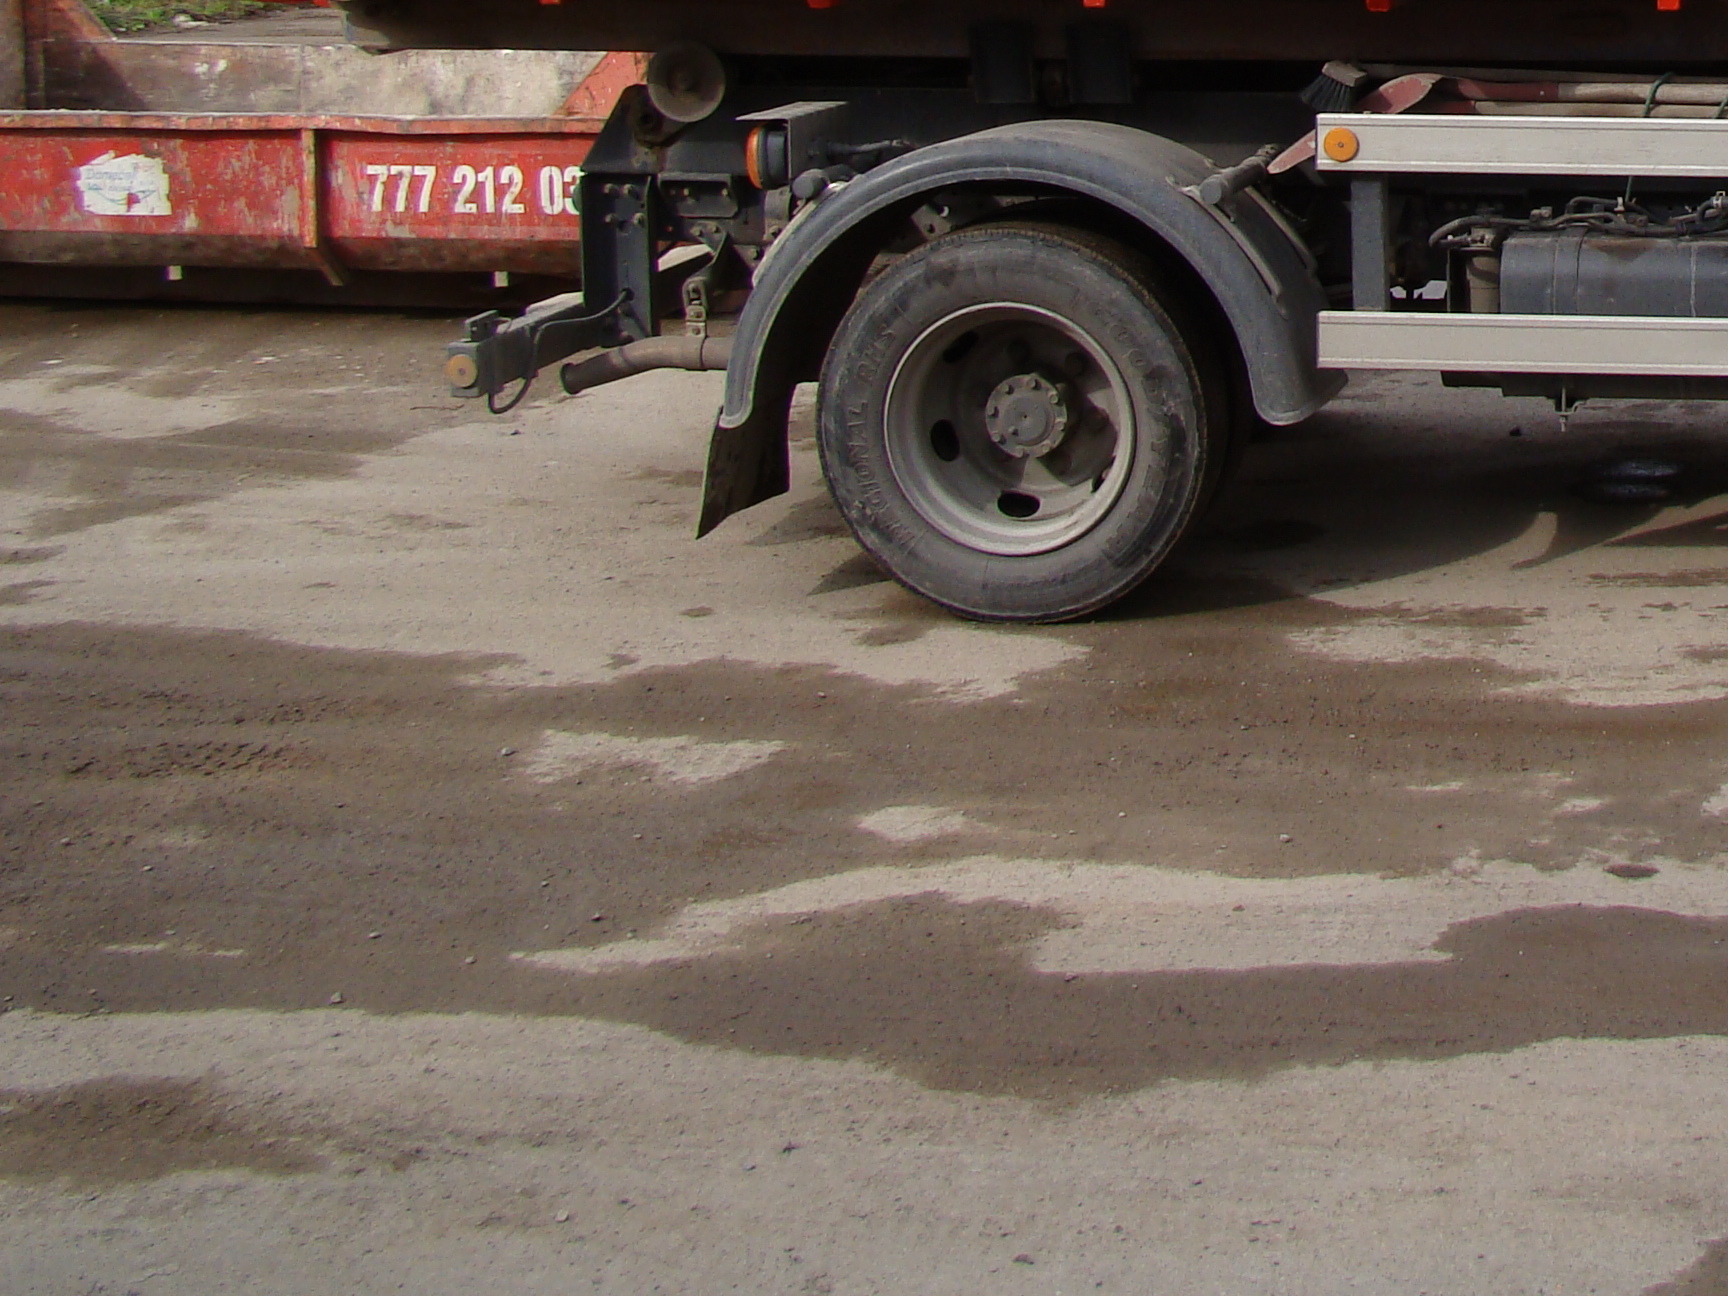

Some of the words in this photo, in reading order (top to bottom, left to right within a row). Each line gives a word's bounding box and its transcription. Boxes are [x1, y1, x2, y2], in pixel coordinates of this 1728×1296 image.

[365, 164, 437, 213] 777
[452, 165, 525, 214] 212
[538, 165, 585, 216] 03
